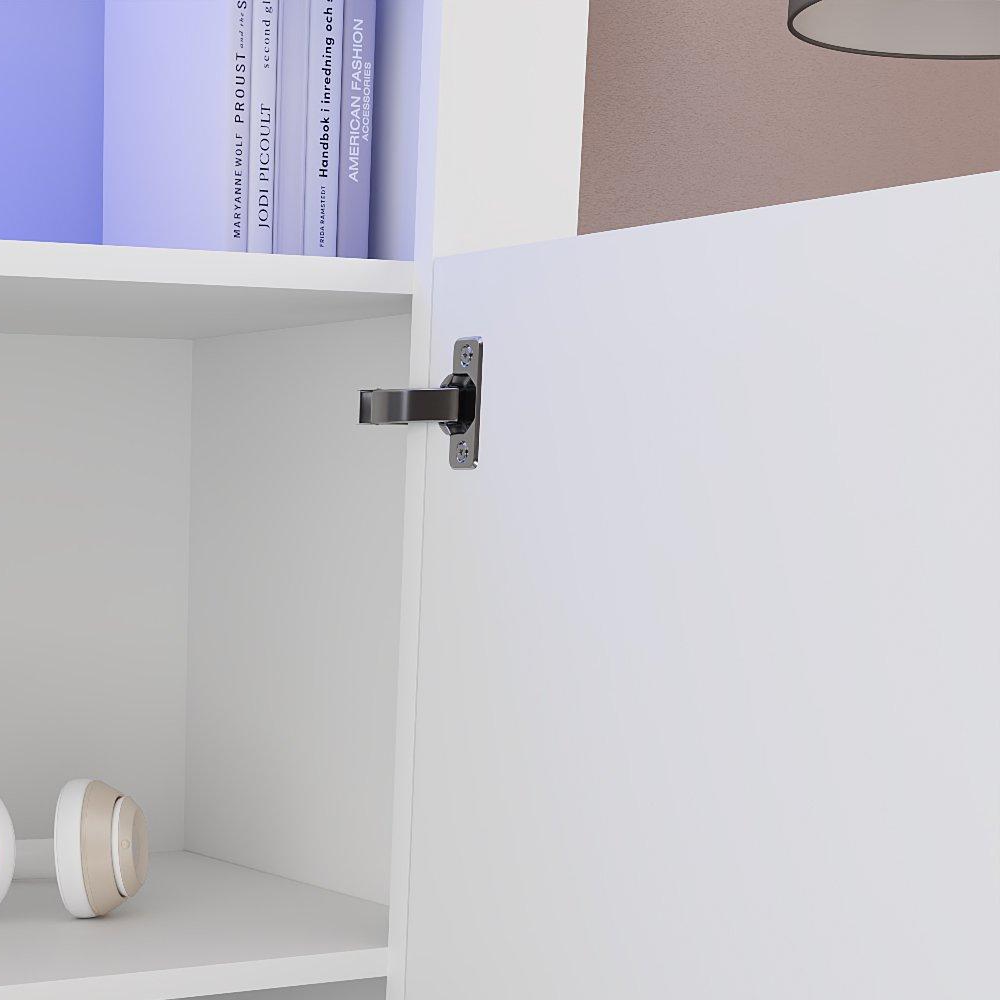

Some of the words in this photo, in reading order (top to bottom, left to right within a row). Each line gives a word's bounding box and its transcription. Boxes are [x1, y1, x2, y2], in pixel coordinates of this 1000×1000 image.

[262, 19, 271, 69] second
[323, 7, 333, 32] och
[234, 52, 246, 124] PROUST
[320, 36, 335, 104] inredning
[351, 18, 364, 91] FASHION
[362, 62, 372, 142] ACCESSORIES
[235, 133, 244, 167] WOLF
[259, 103, 271, 182] PICOULT
[318, 117, 330, 178] Handbok
[348, 96, 361, 183] AMERICAN
[233, 170, 243, 239] MARYANNE
[258, 189, 270, 229] JODI
